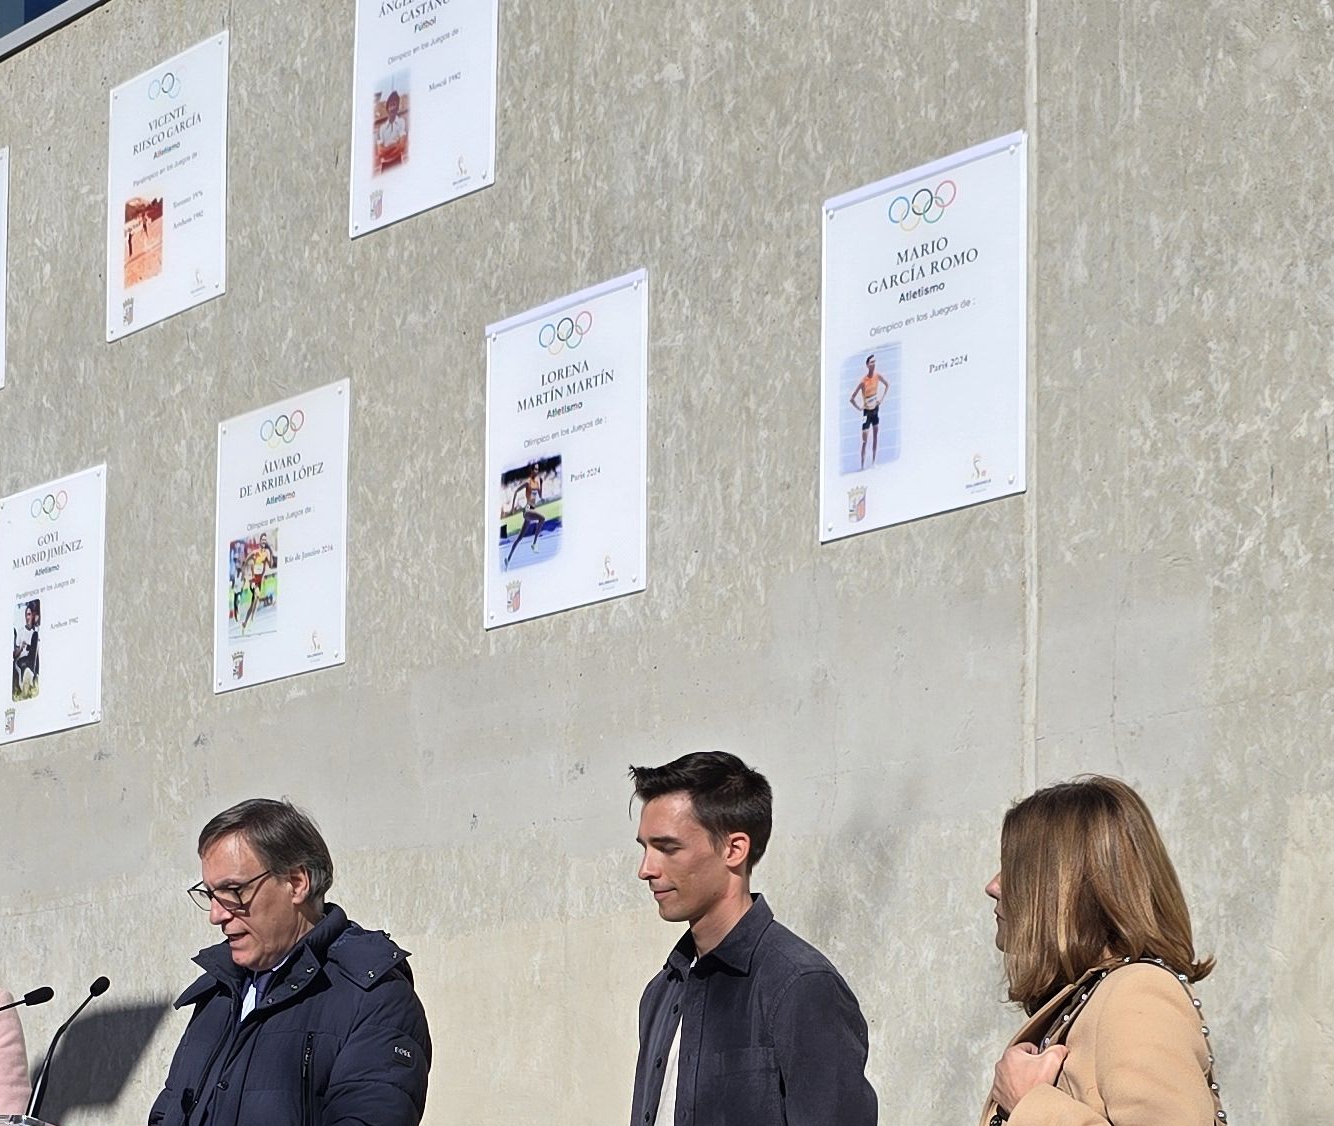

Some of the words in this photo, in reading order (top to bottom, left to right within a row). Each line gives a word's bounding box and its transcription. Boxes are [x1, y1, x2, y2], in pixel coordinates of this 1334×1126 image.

[148, 104, 187, 132] VICENTE
[132, 131, 165, 156] RIESCO
[166, 112, 202, 137] GARCÍA
[896, 236, 948, 265] MARIO
[867, 264, 926, 295] GARCÍA
[930, 247, 979, 275] ROMO
[899, 281, 945, 303] Atletismo
[905, 316, 915, 327] en
[916, 312, 928, 322] los
[930, 302, 958, 318] Juegos
[960, 298, 971, 309] de
[541, 360, 589, 386] LORENA
[517, 385, 563, 412] MARTÍN
[566, 368, 614, 397] MARTÍN
[547, 401, 583, 419] Atletismo
[570, 420, 594, 433] Juegos
[262, 452, 301, 475] ÁLVARO
[239, 484, 253, 498] DE
[254, 473, 291, 495] ARRIBA
[293, 462, 324, 482] LÓPEZ
[265, 490, 296, 506] Atletismo
[37, 531, 59, 547] GOYI
[12, 550, 46, 569] MADRID
[47, 539, 83, 561] JIMÉNEZ
